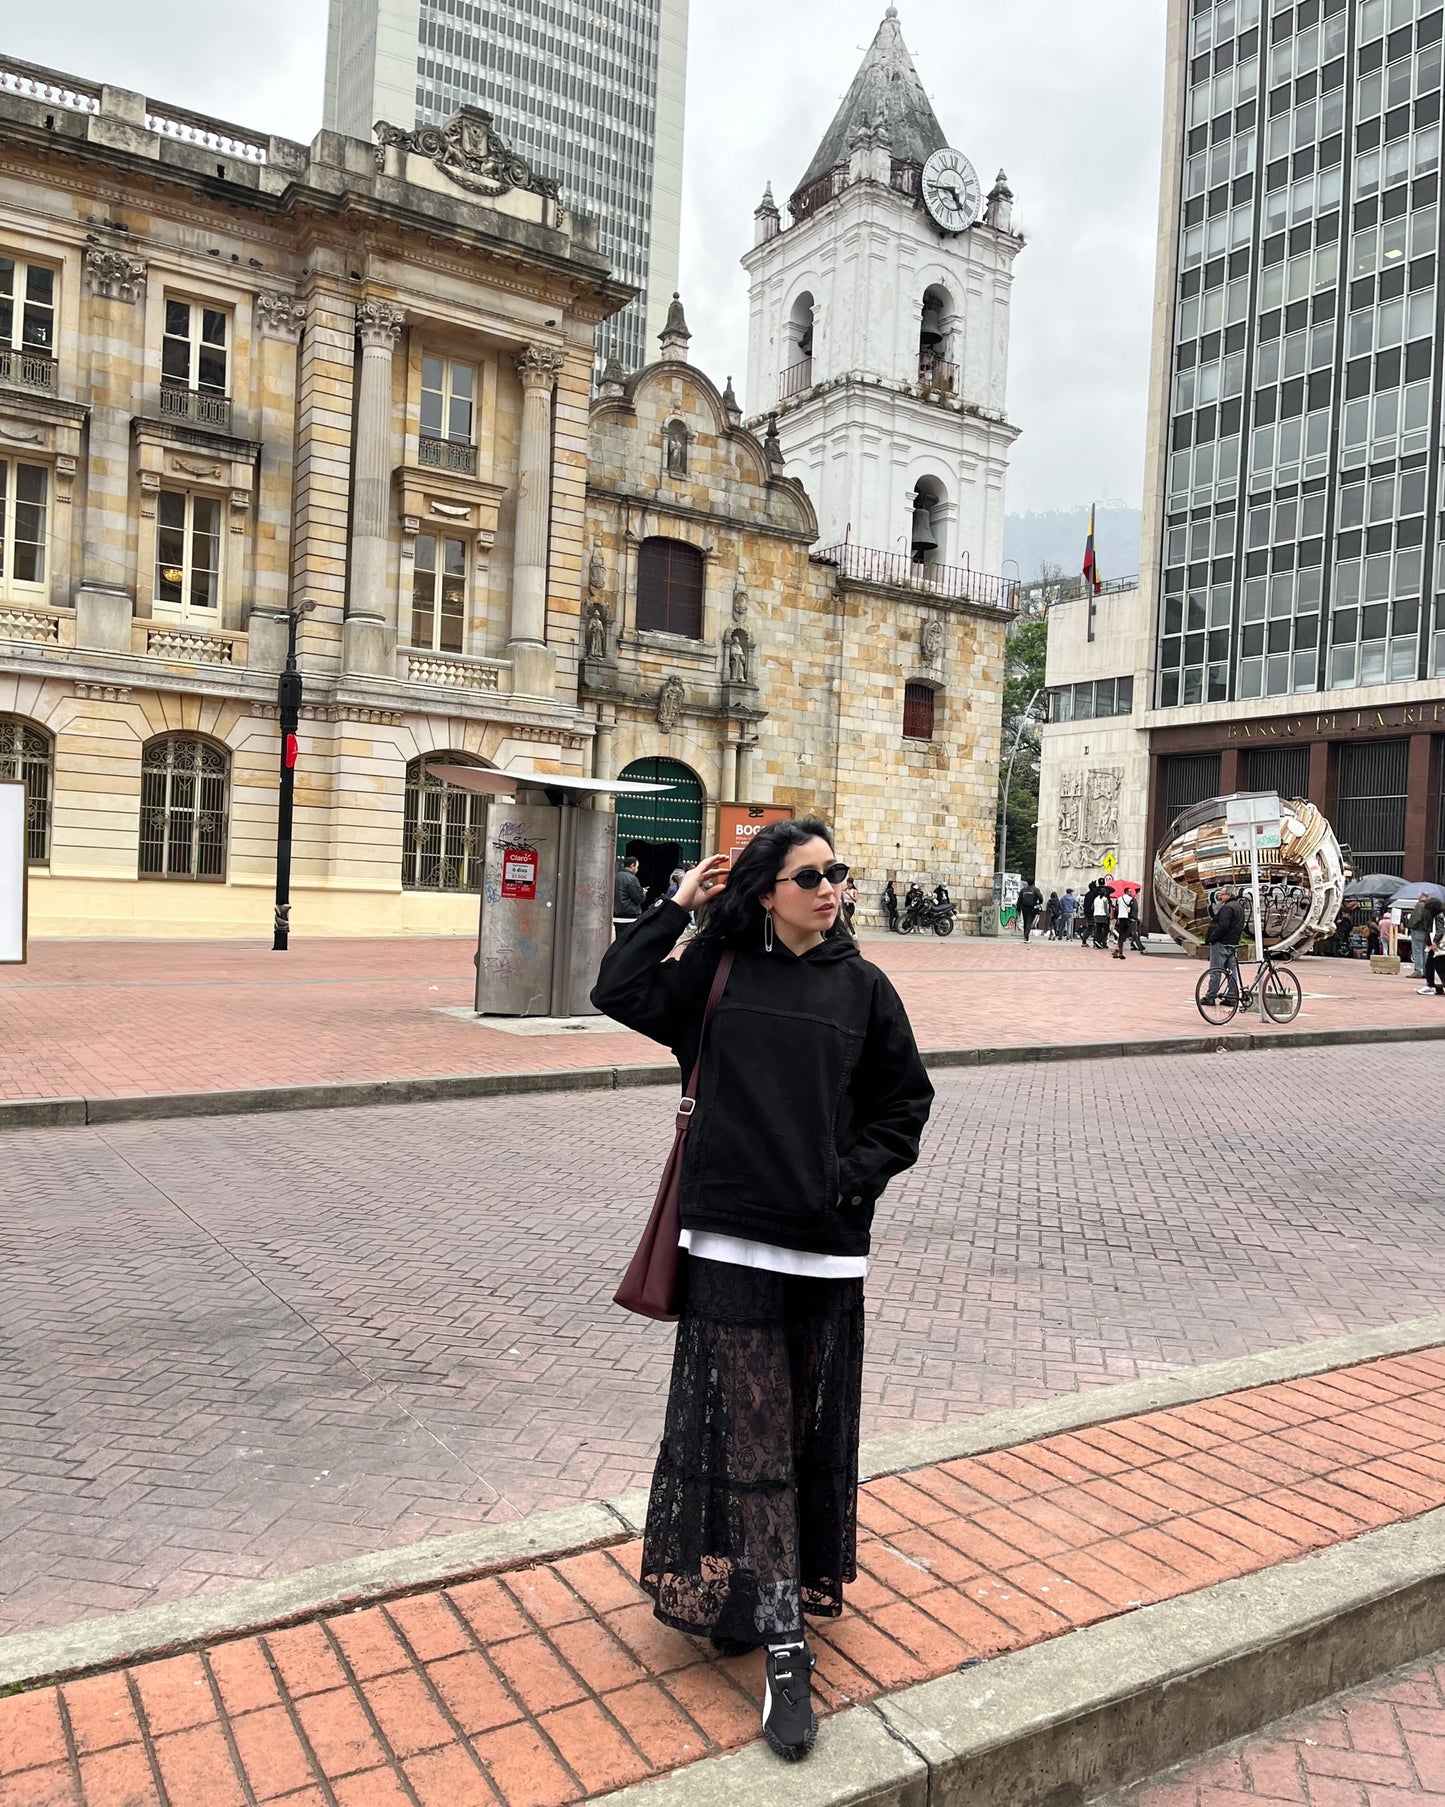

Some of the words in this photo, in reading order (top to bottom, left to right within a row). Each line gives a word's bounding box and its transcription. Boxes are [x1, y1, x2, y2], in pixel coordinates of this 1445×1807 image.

[1228, 721, 1301, 739] BANCO
[735, 824, 767, 836] BOG
[510, 854, 530, 862] Claro
